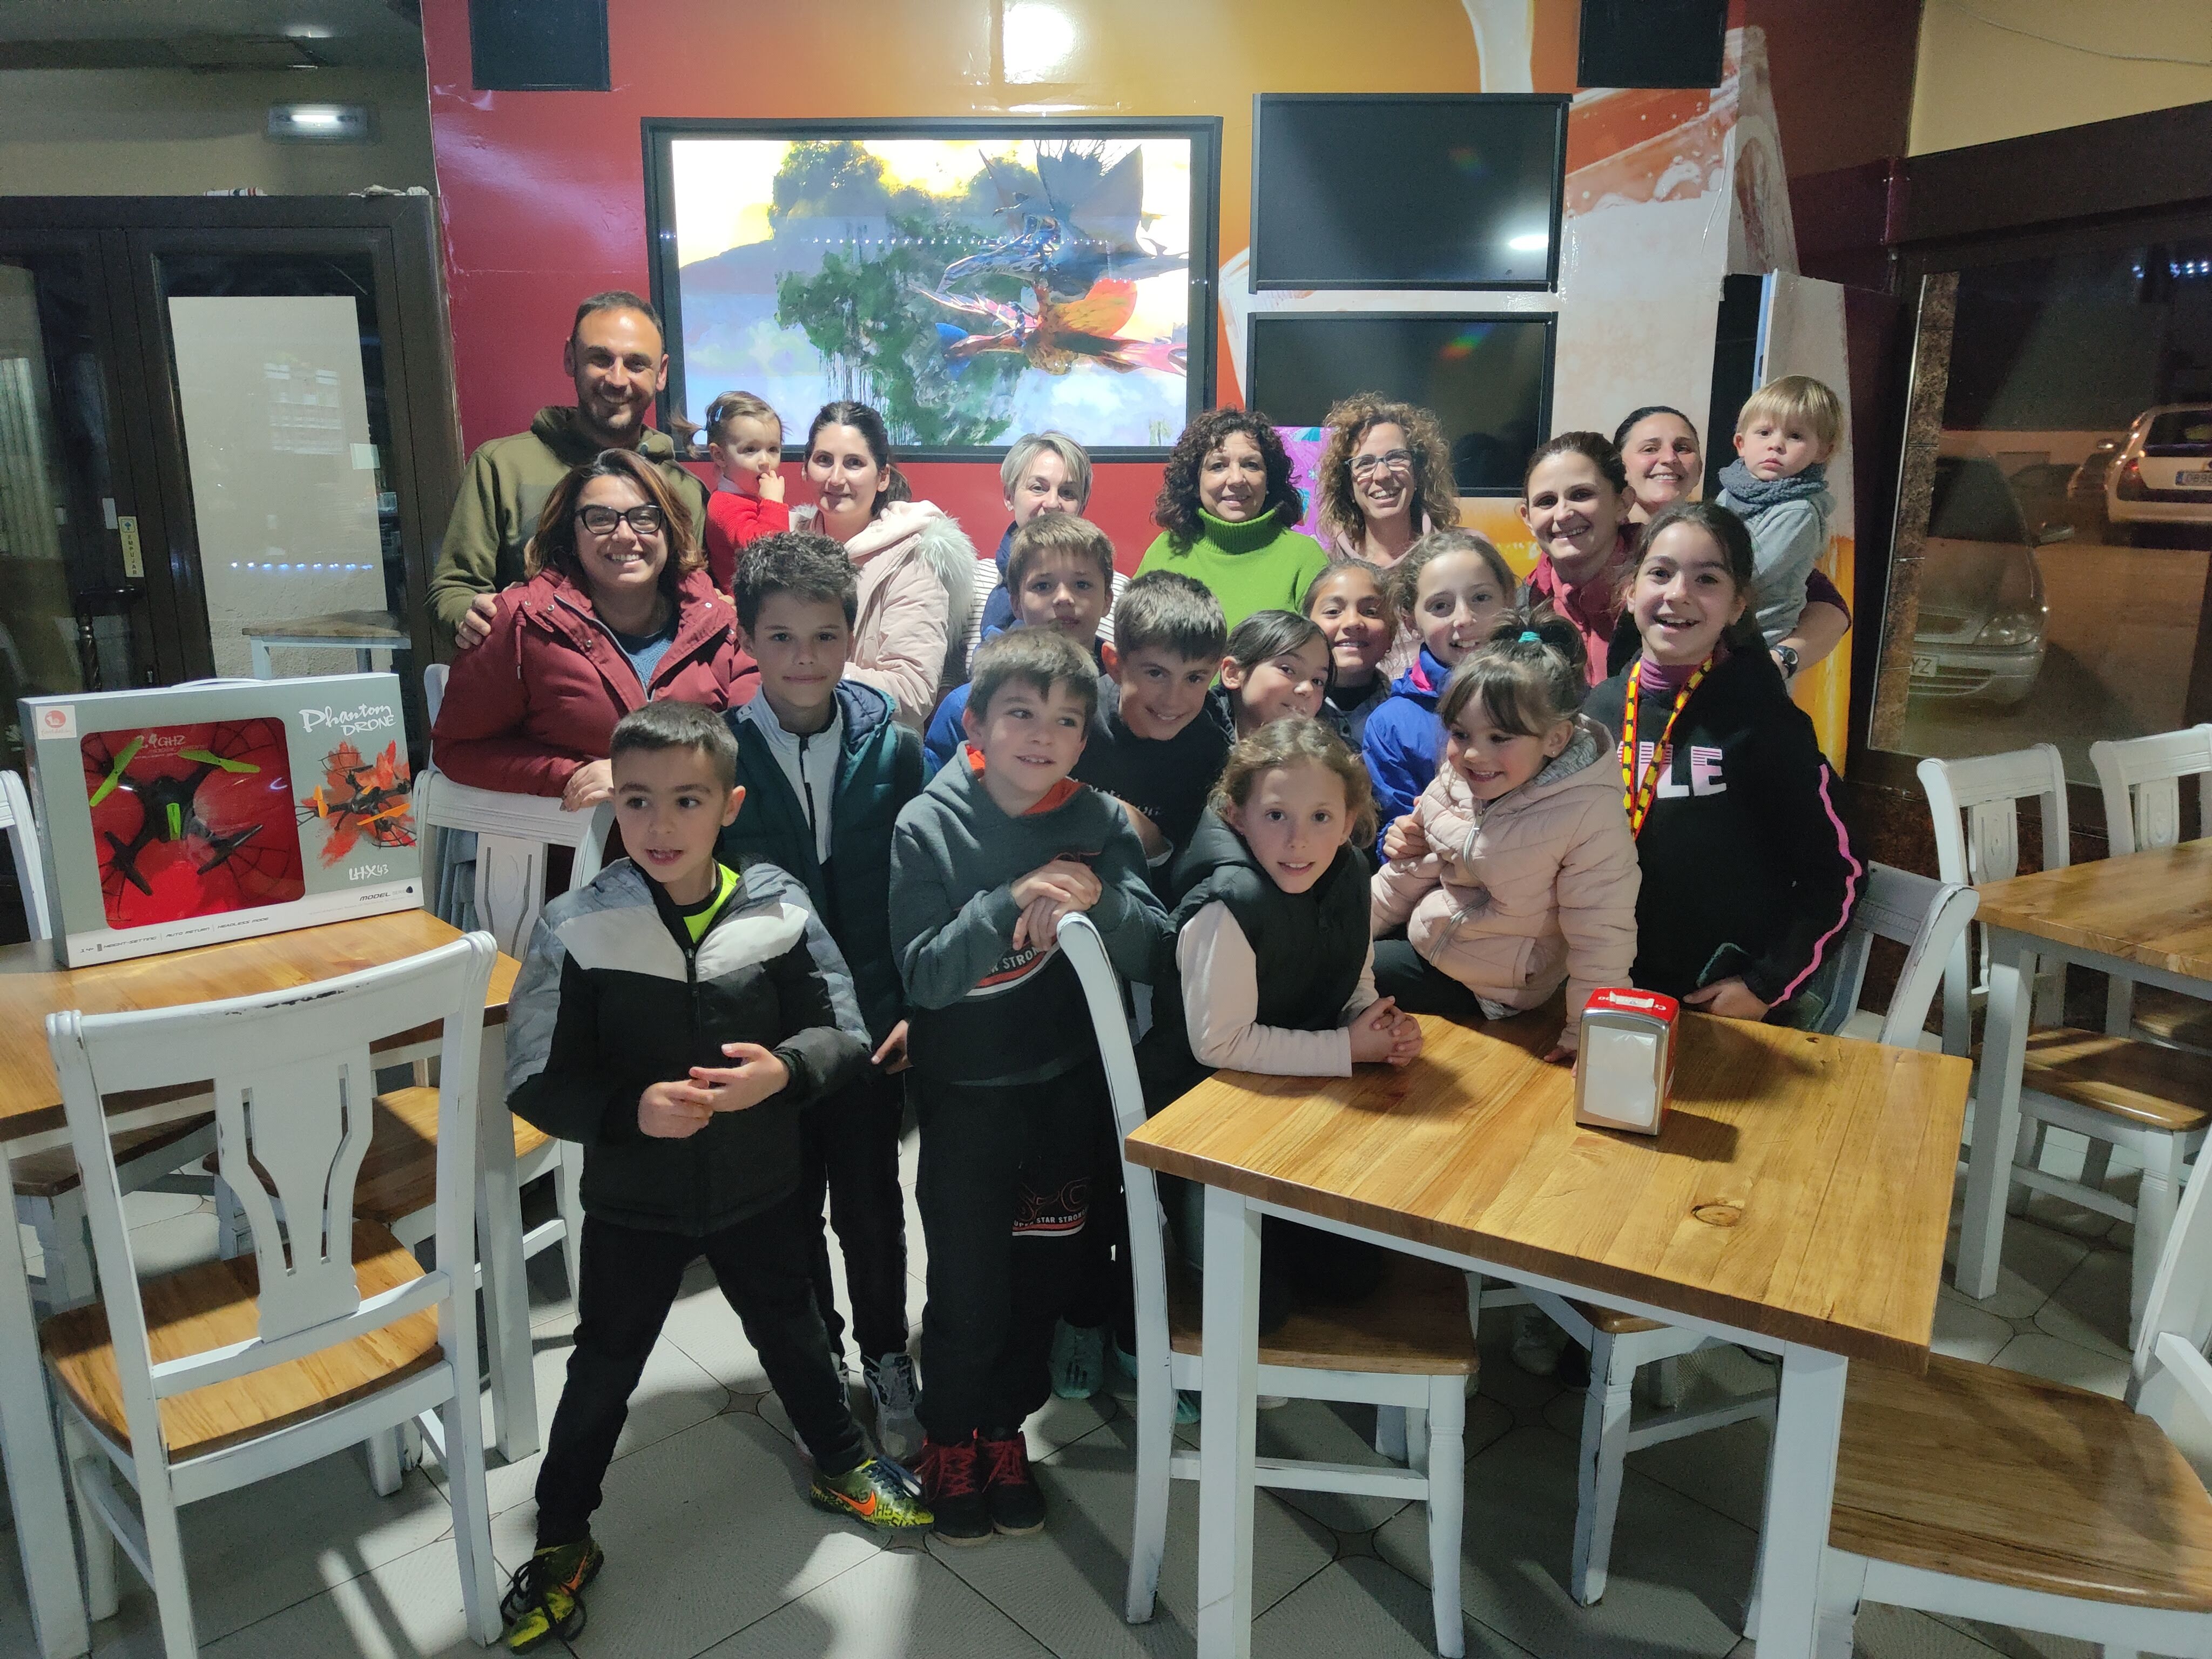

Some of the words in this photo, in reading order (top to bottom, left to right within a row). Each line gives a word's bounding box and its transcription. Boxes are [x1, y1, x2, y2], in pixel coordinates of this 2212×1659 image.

[128, 534, 137, 575] EMPUJAR
[299, 703, 392, 733] Phantom
[340, 714, 397, 736] DRONE
[359, 892, 391, 901] MODEL
[185, 927, 210, 935] RETURN
[217, 920, 250, 929] HEADLESS
[1002, 946, 1040, 969] STRON
